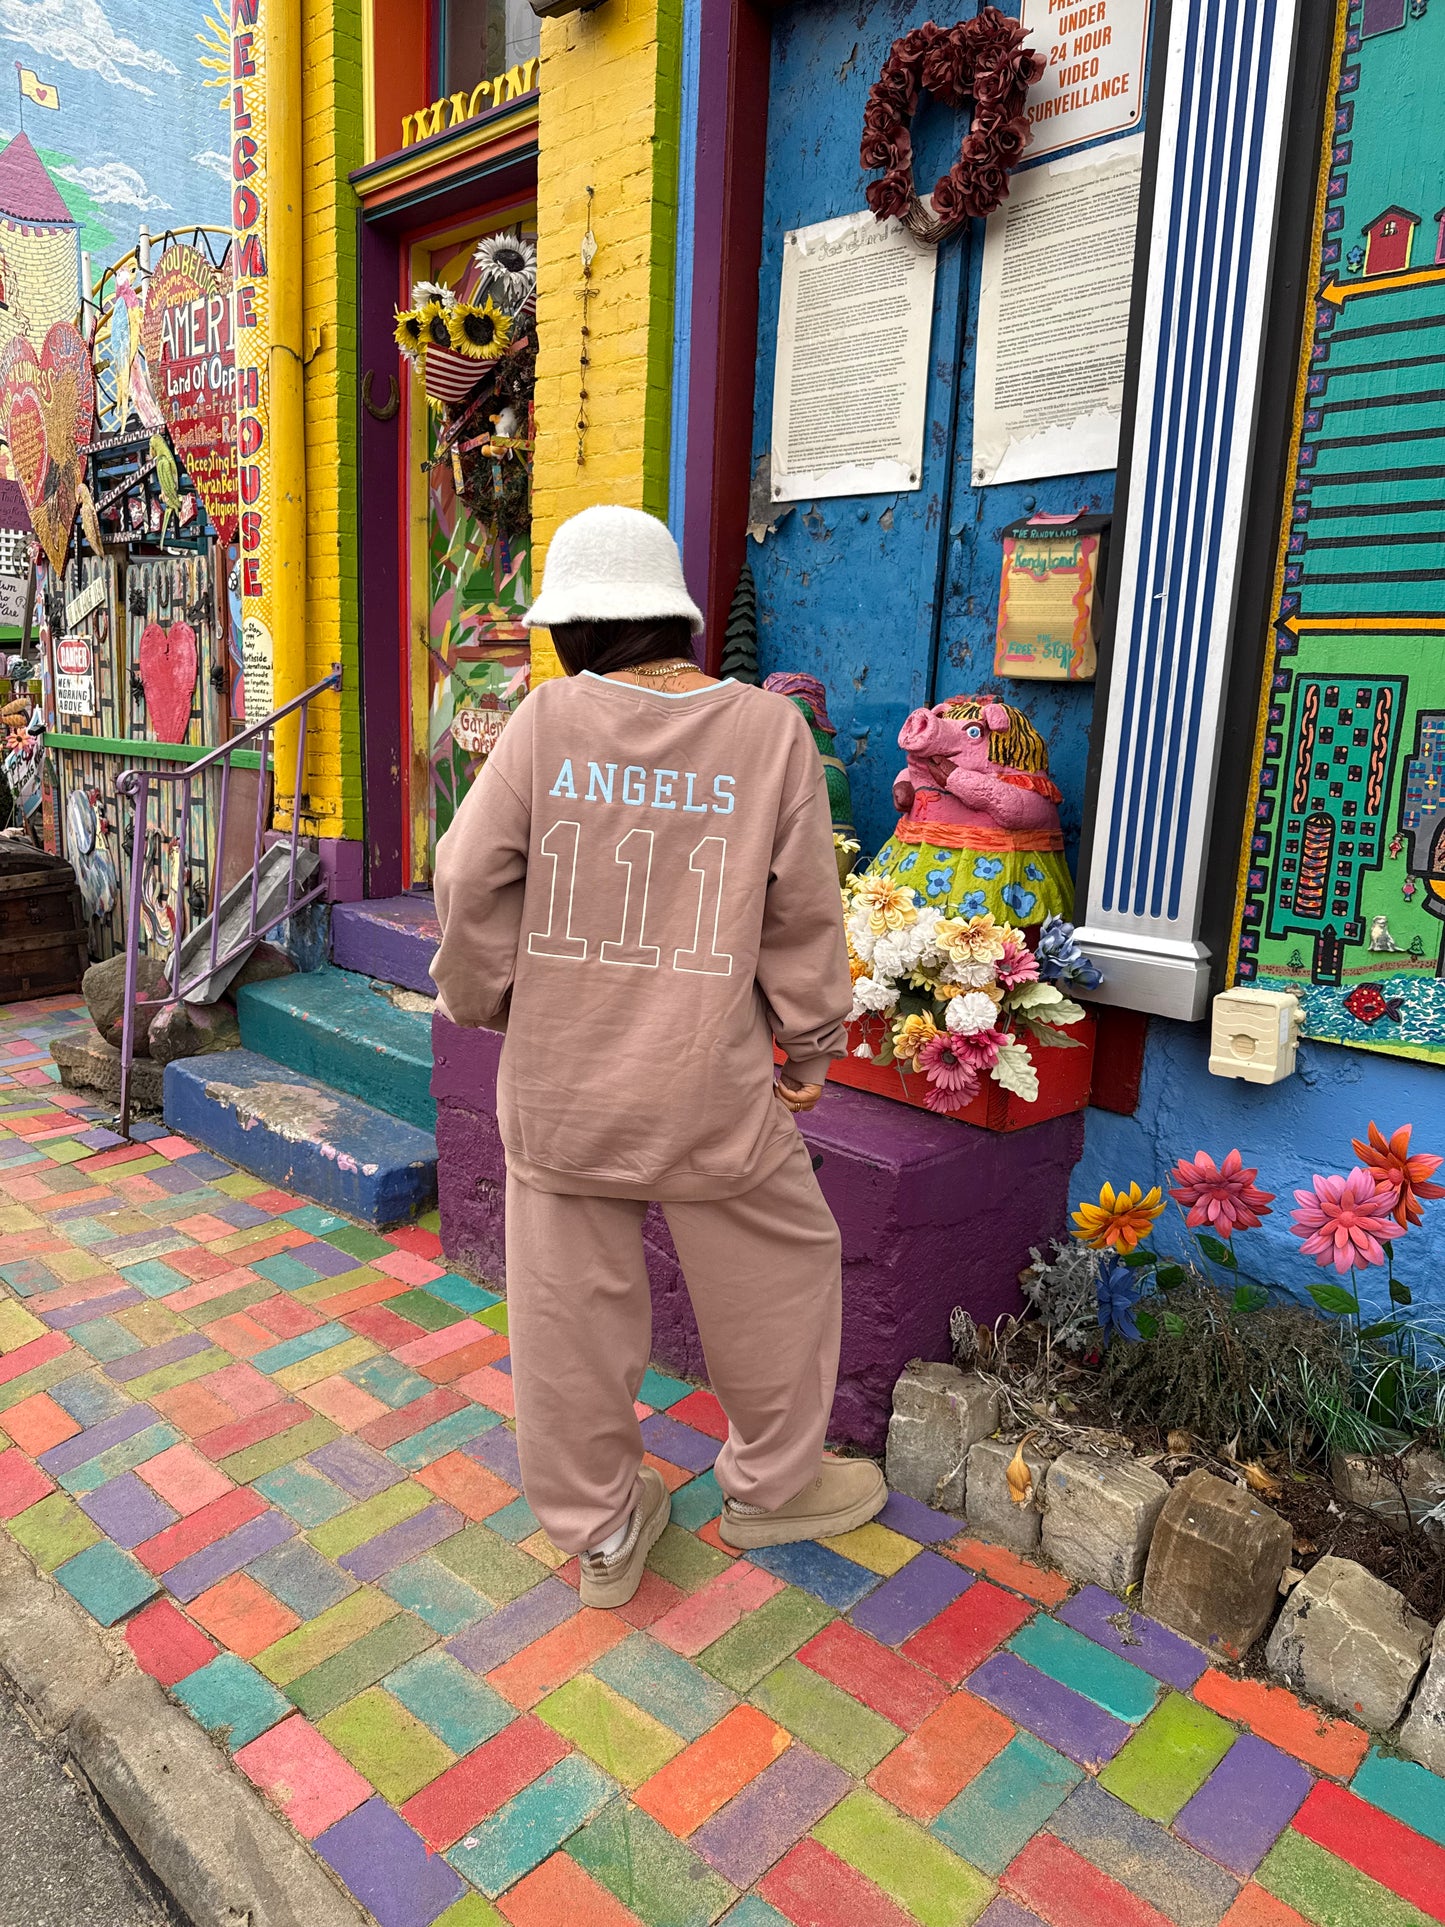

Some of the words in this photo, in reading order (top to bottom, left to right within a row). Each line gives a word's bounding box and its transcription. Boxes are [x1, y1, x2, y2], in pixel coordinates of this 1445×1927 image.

[1058, 1, 1106, 36] UNDER
[1049, 42, 1067, 66] 24
[1073, 25, 1112, 57] HOUR
[1058, 57, 1099, 88] VIDEO
[1027, 72, 1130, 125] SURVEILLANCE
[160, 247, 180, 277] YOU
[158, 291, 236, 362] AMERI
[167, 368, 191, 397] Land
[237, 367, 263, 597] HOUSE
[60, 646, 87, 668] DANGER
[58, 688, 88, 701] WORKING
[59, 700, 82, 712] ABOVE
[549, 758, 736, 815] ANGELS
[528, 820, 733, 976] 111
